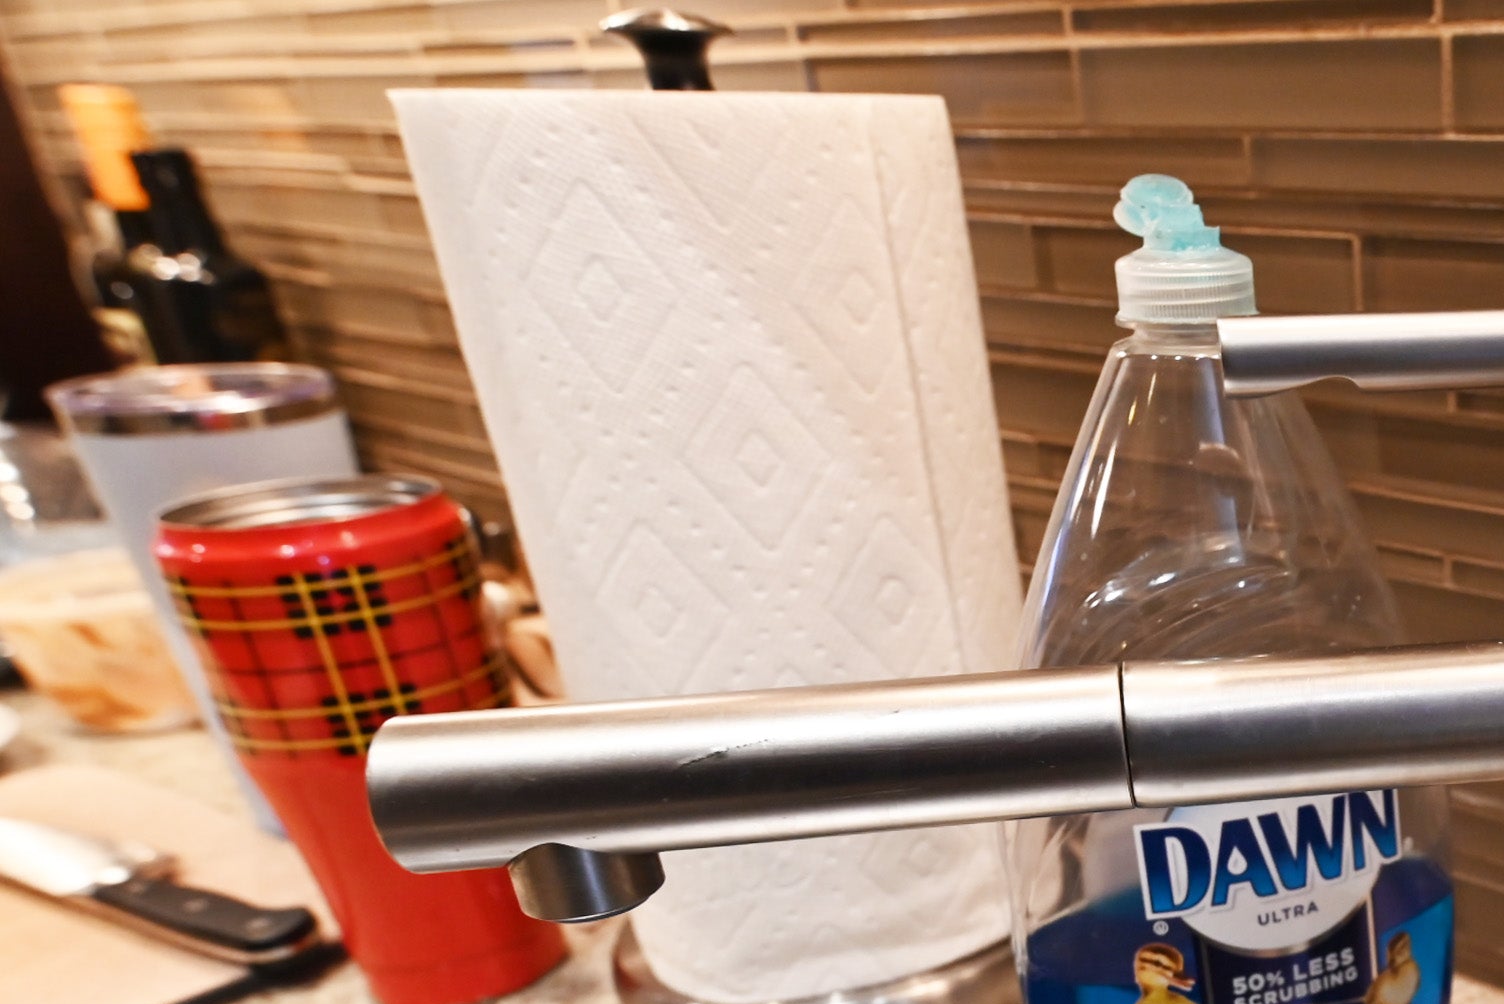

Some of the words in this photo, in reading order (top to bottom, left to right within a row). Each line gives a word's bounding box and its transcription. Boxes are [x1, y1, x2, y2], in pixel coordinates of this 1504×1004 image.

[1140, 789, 1398, 914] DAWN
[1257, 902, 1319, 926] ULTRA
[1232, 970, 1285, 995] 50%
[1292, 947, 1355, 981] LESS
